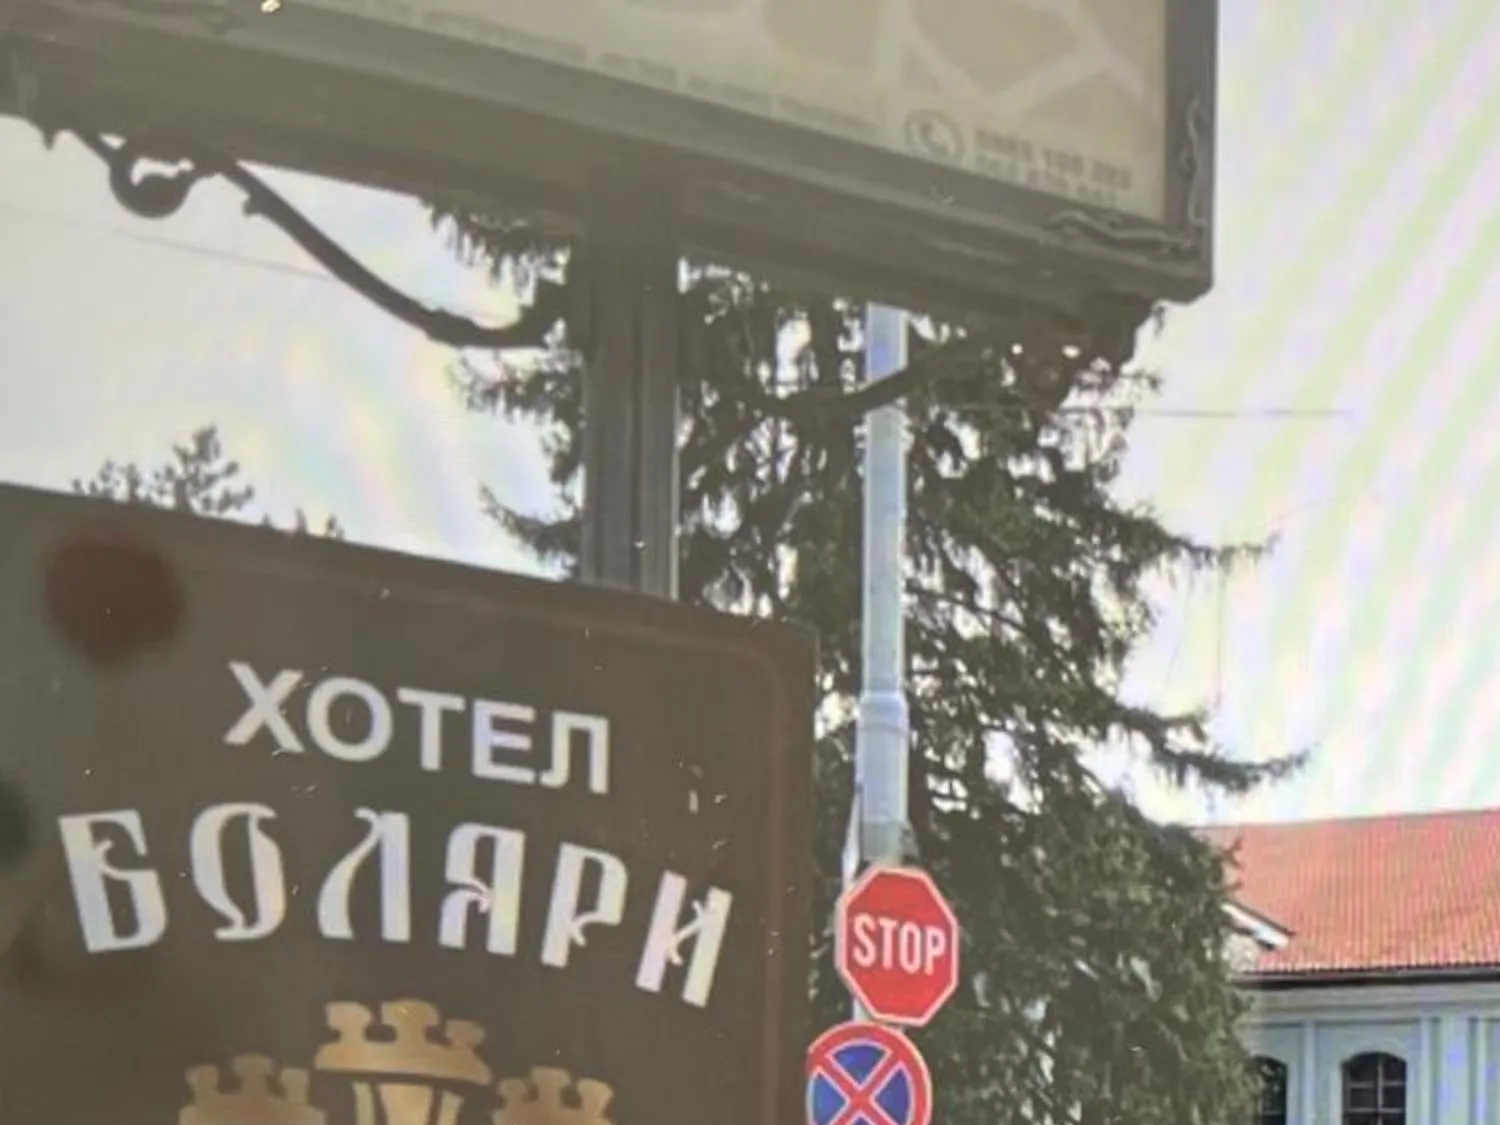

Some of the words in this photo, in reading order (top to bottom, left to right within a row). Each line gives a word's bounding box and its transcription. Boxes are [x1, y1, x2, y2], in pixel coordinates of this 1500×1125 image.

[224, 661, 609, 794] ХОТЕЛ
[58, 802, 733, 1008] БОЛЯРИ
[853, 912, 946, 976] STOP
